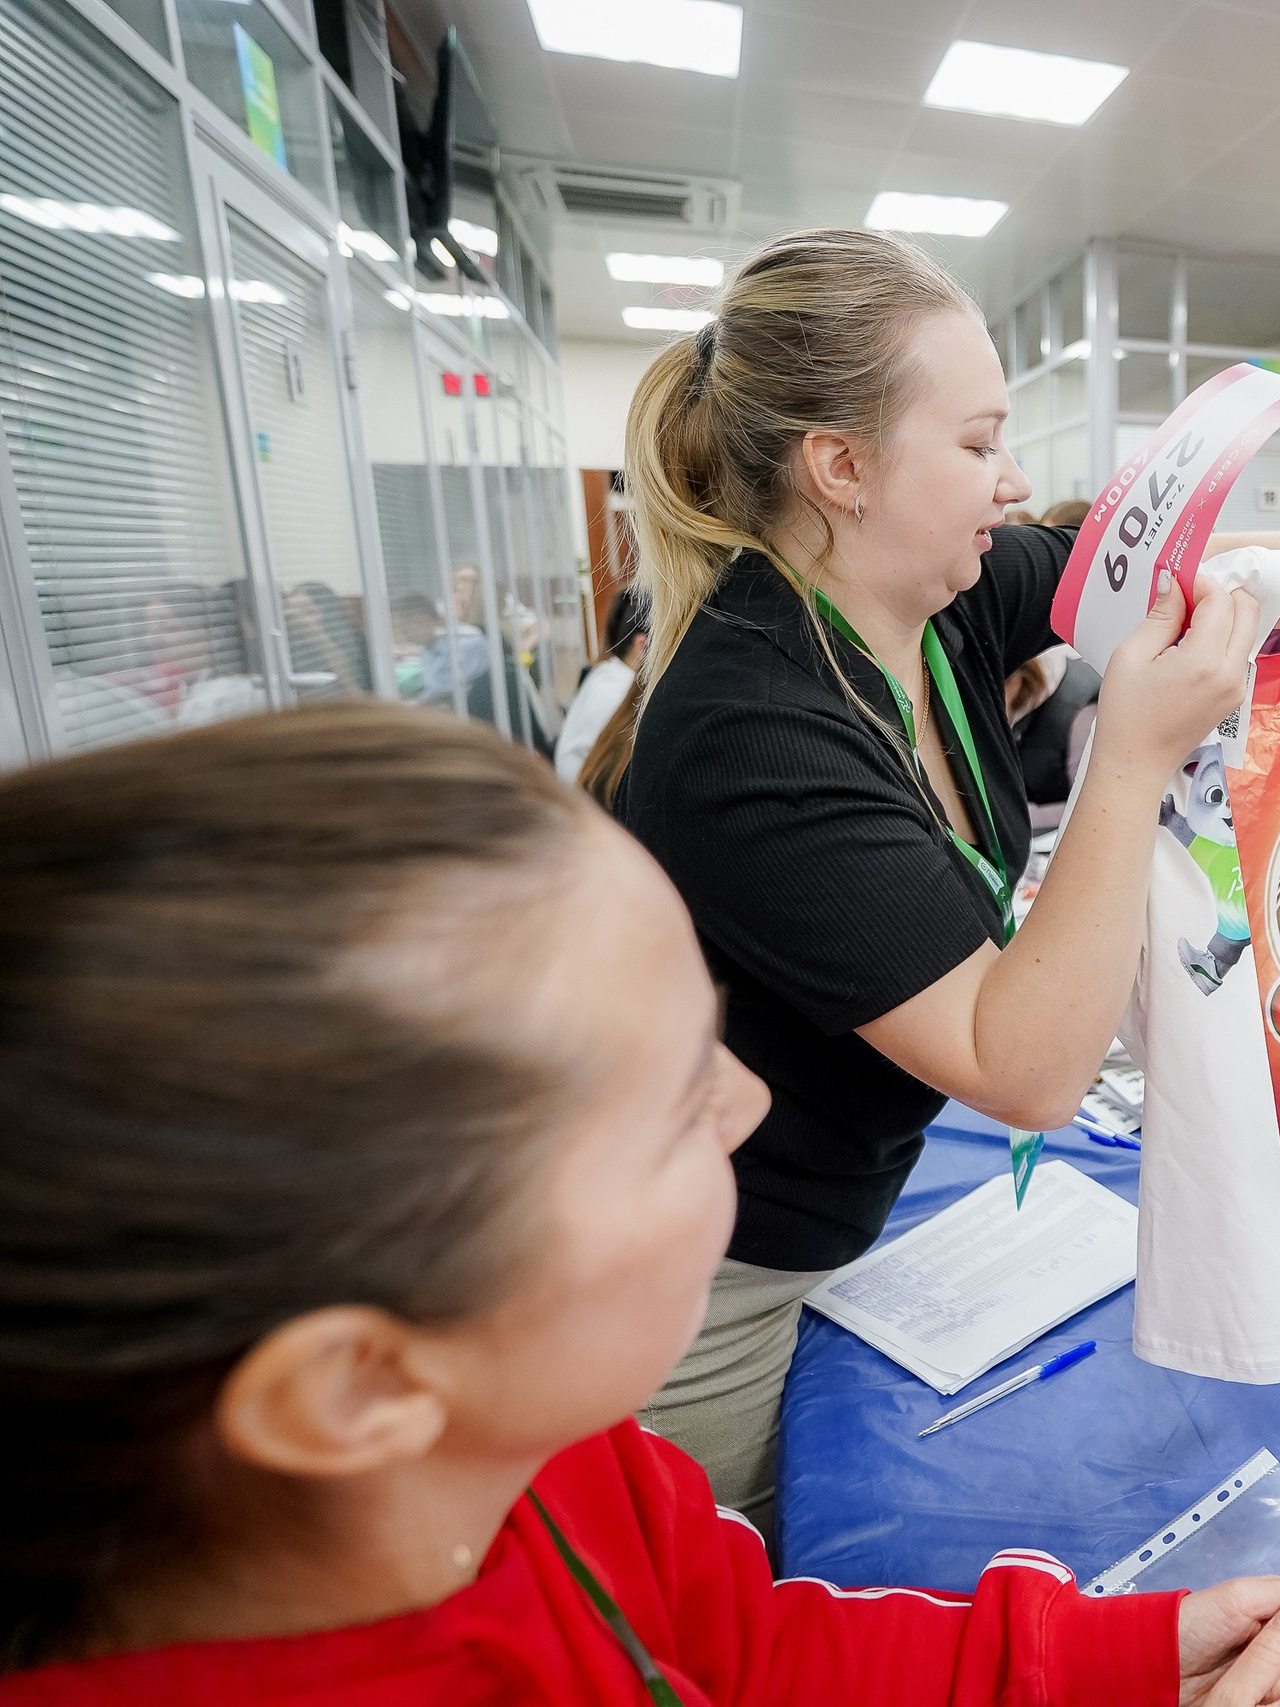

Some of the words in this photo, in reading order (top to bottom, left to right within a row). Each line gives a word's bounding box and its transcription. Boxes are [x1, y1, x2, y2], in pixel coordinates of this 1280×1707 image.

[1208, 449, 1239, 493] СБЕР
[1104, 431, 1204, 592] 2709
[1166, 483, 1185, 510] 7-9
[1144, 514, 1164, 551] ЛЕТ
[1169, 513, 1195, 563] марафон
[1173, 523, 1197, 572] зелёный
